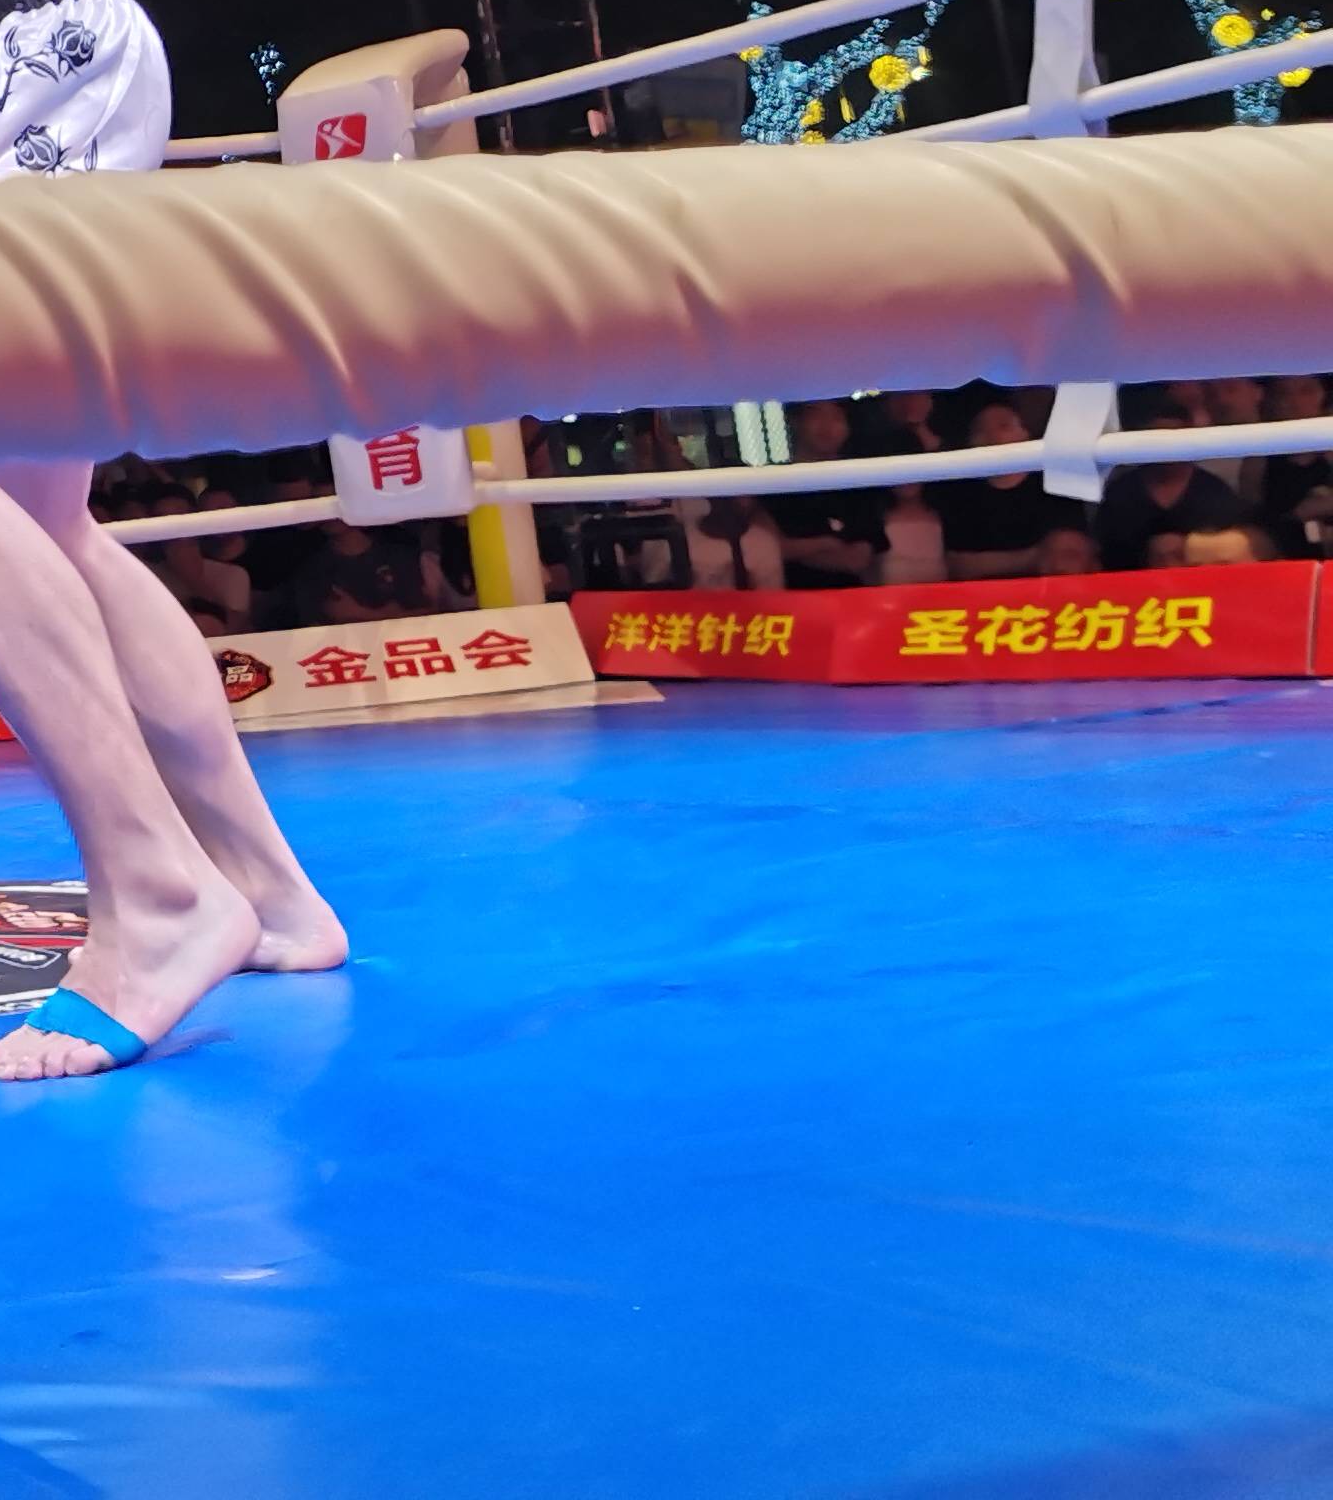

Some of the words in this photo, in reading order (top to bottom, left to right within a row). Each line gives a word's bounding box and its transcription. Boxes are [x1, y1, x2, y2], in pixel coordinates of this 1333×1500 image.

[604, 612, 793, 656] 洋洋针织
[899, 597, 1214, 656] 圣花纺织
[296, 629, 533, 688] 金品会
